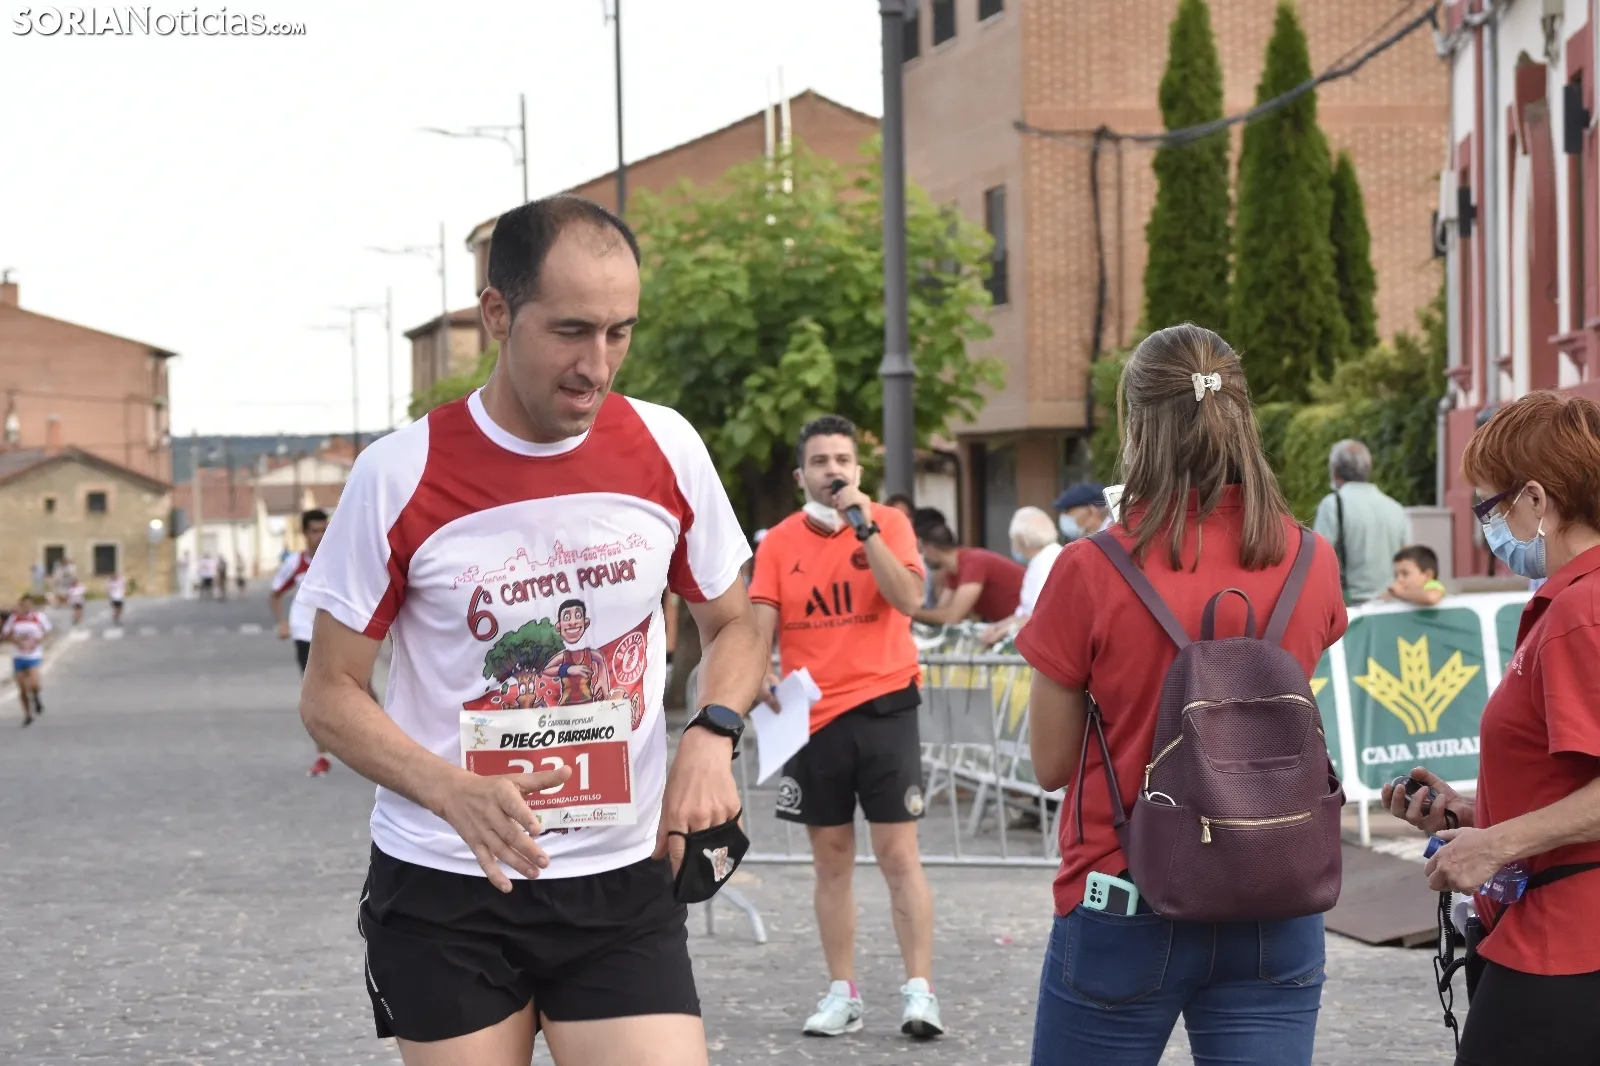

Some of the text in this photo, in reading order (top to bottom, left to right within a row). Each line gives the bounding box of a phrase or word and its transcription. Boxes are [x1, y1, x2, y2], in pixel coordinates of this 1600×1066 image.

[500, 725, 615, 748] DIEGO BARRANCO
[1361, 743, 1414, 765] CAJA
[525, 793, 601, 807] EDRO GONZALO DELSO
